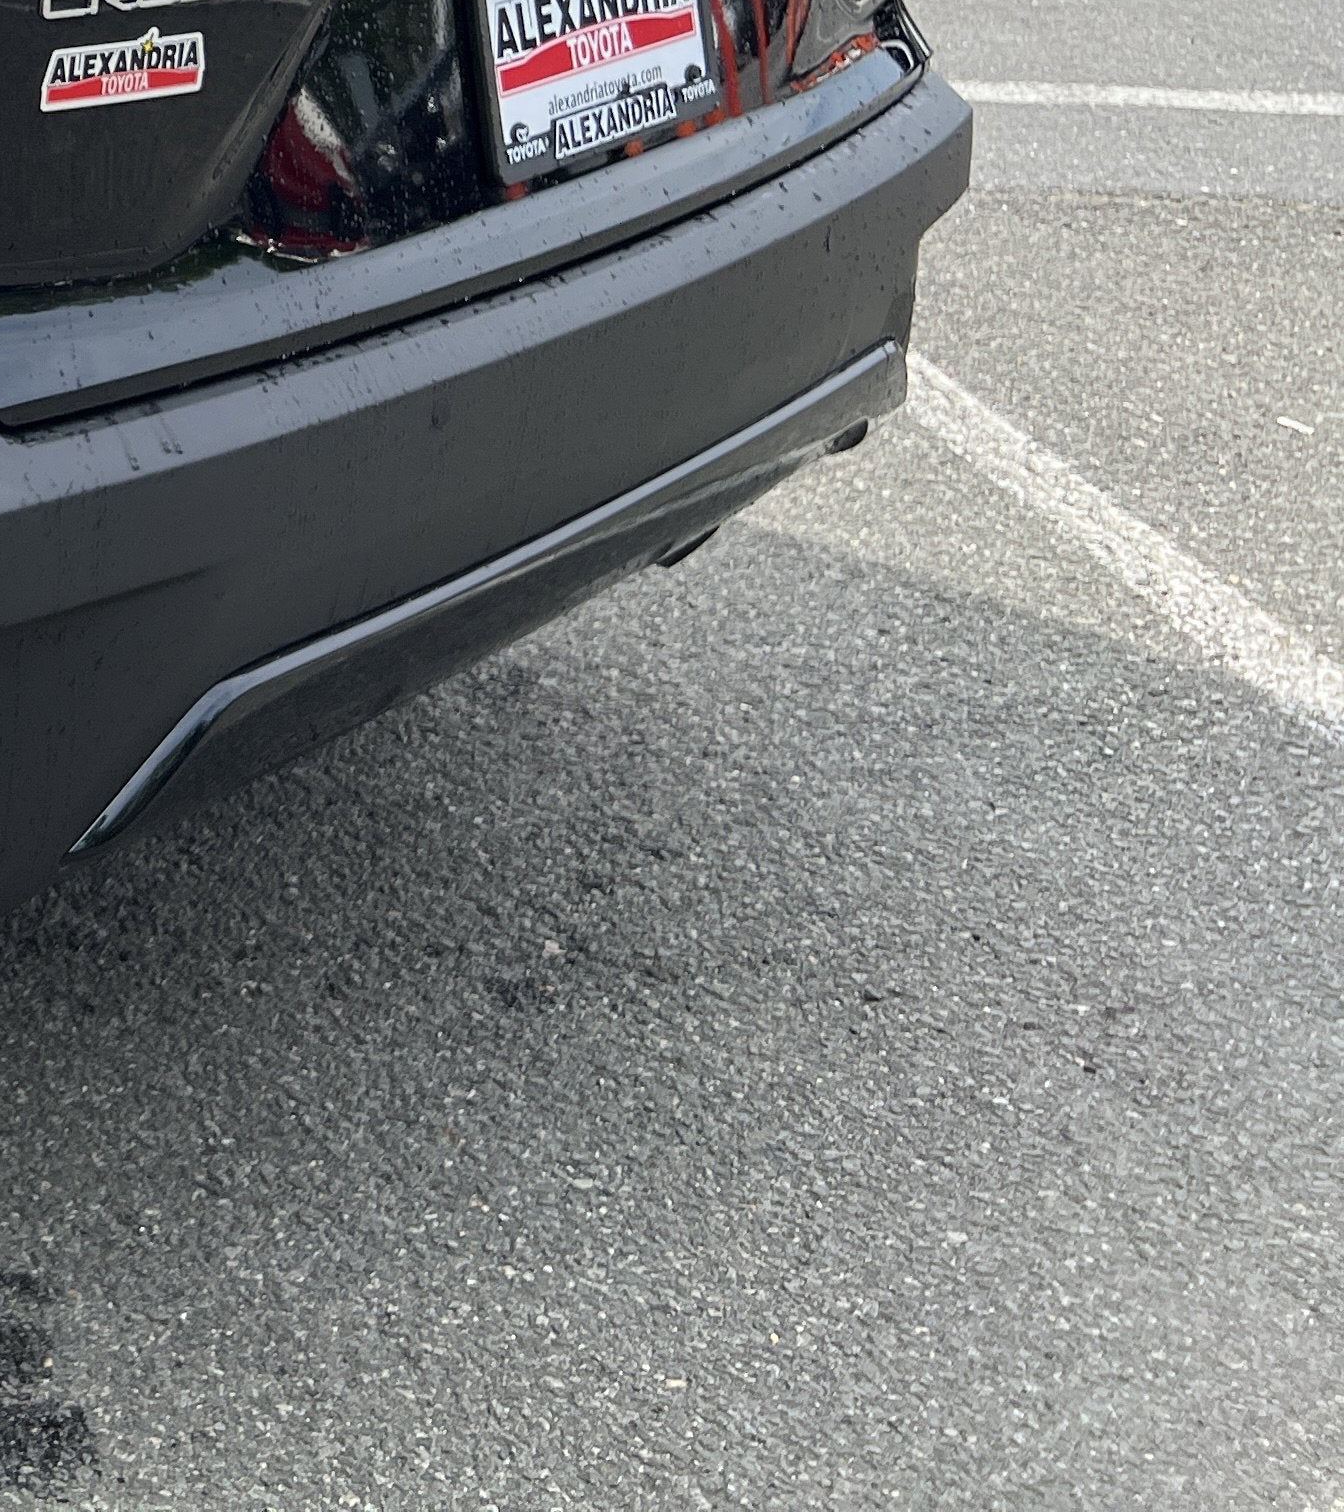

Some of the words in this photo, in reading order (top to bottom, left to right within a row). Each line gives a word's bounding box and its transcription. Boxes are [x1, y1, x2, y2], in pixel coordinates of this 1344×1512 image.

[50, 40, 198, 85] ALEXANDRIA
[566, 22, 633, 68] TOYOTA
[101, 72, 149, 96] TOYOTA
[506, 137, 547, 165] TOYOTA
[557, 88, 675, 155] ALEXANDRIA
[681, 79, 716, 104] TOYOTA
